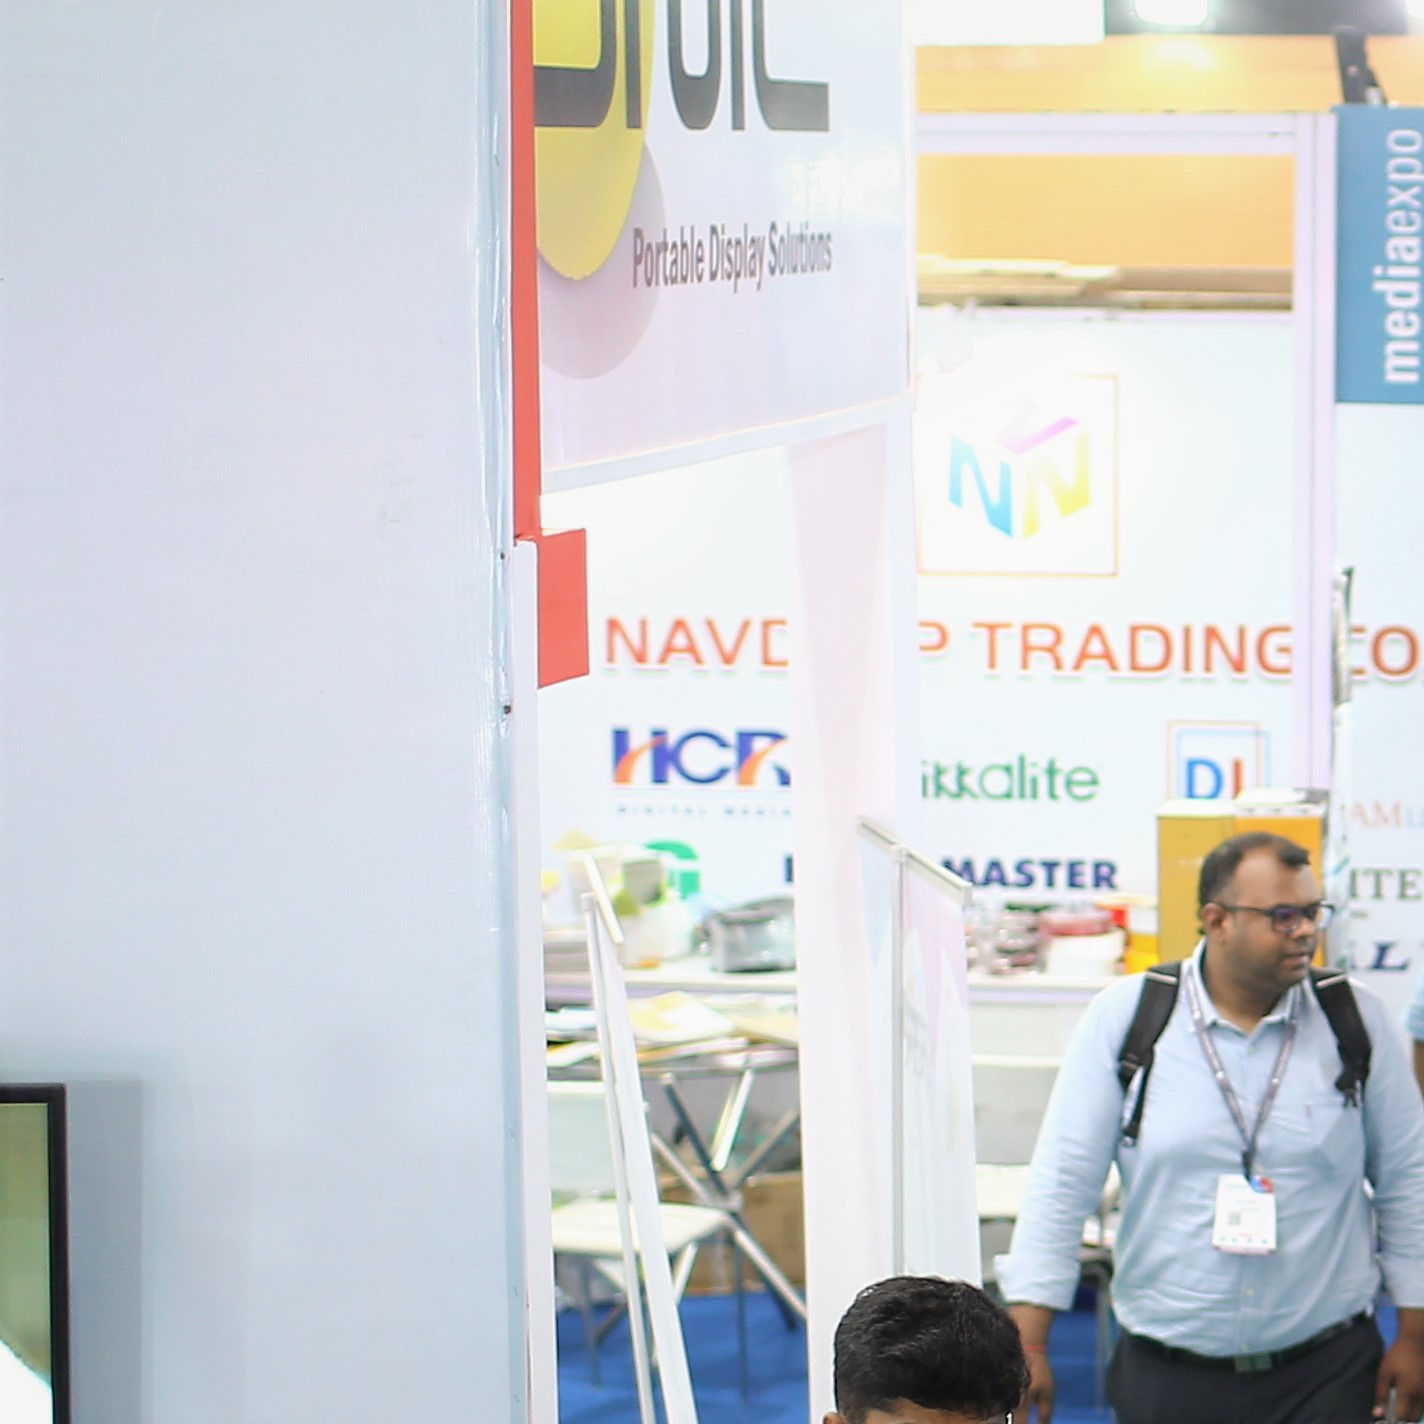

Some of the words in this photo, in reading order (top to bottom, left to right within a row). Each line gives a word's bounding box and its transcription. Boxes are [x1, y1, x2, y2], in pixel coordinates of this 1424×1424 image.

[633, 225, 705, 288] Portable
[709, 223, 765, 294] Display
[768, 220, 832, 277] Solutions
[972, 621, 1292, 675] TRADING
[922, 753, 1100, 802] ikkalite
